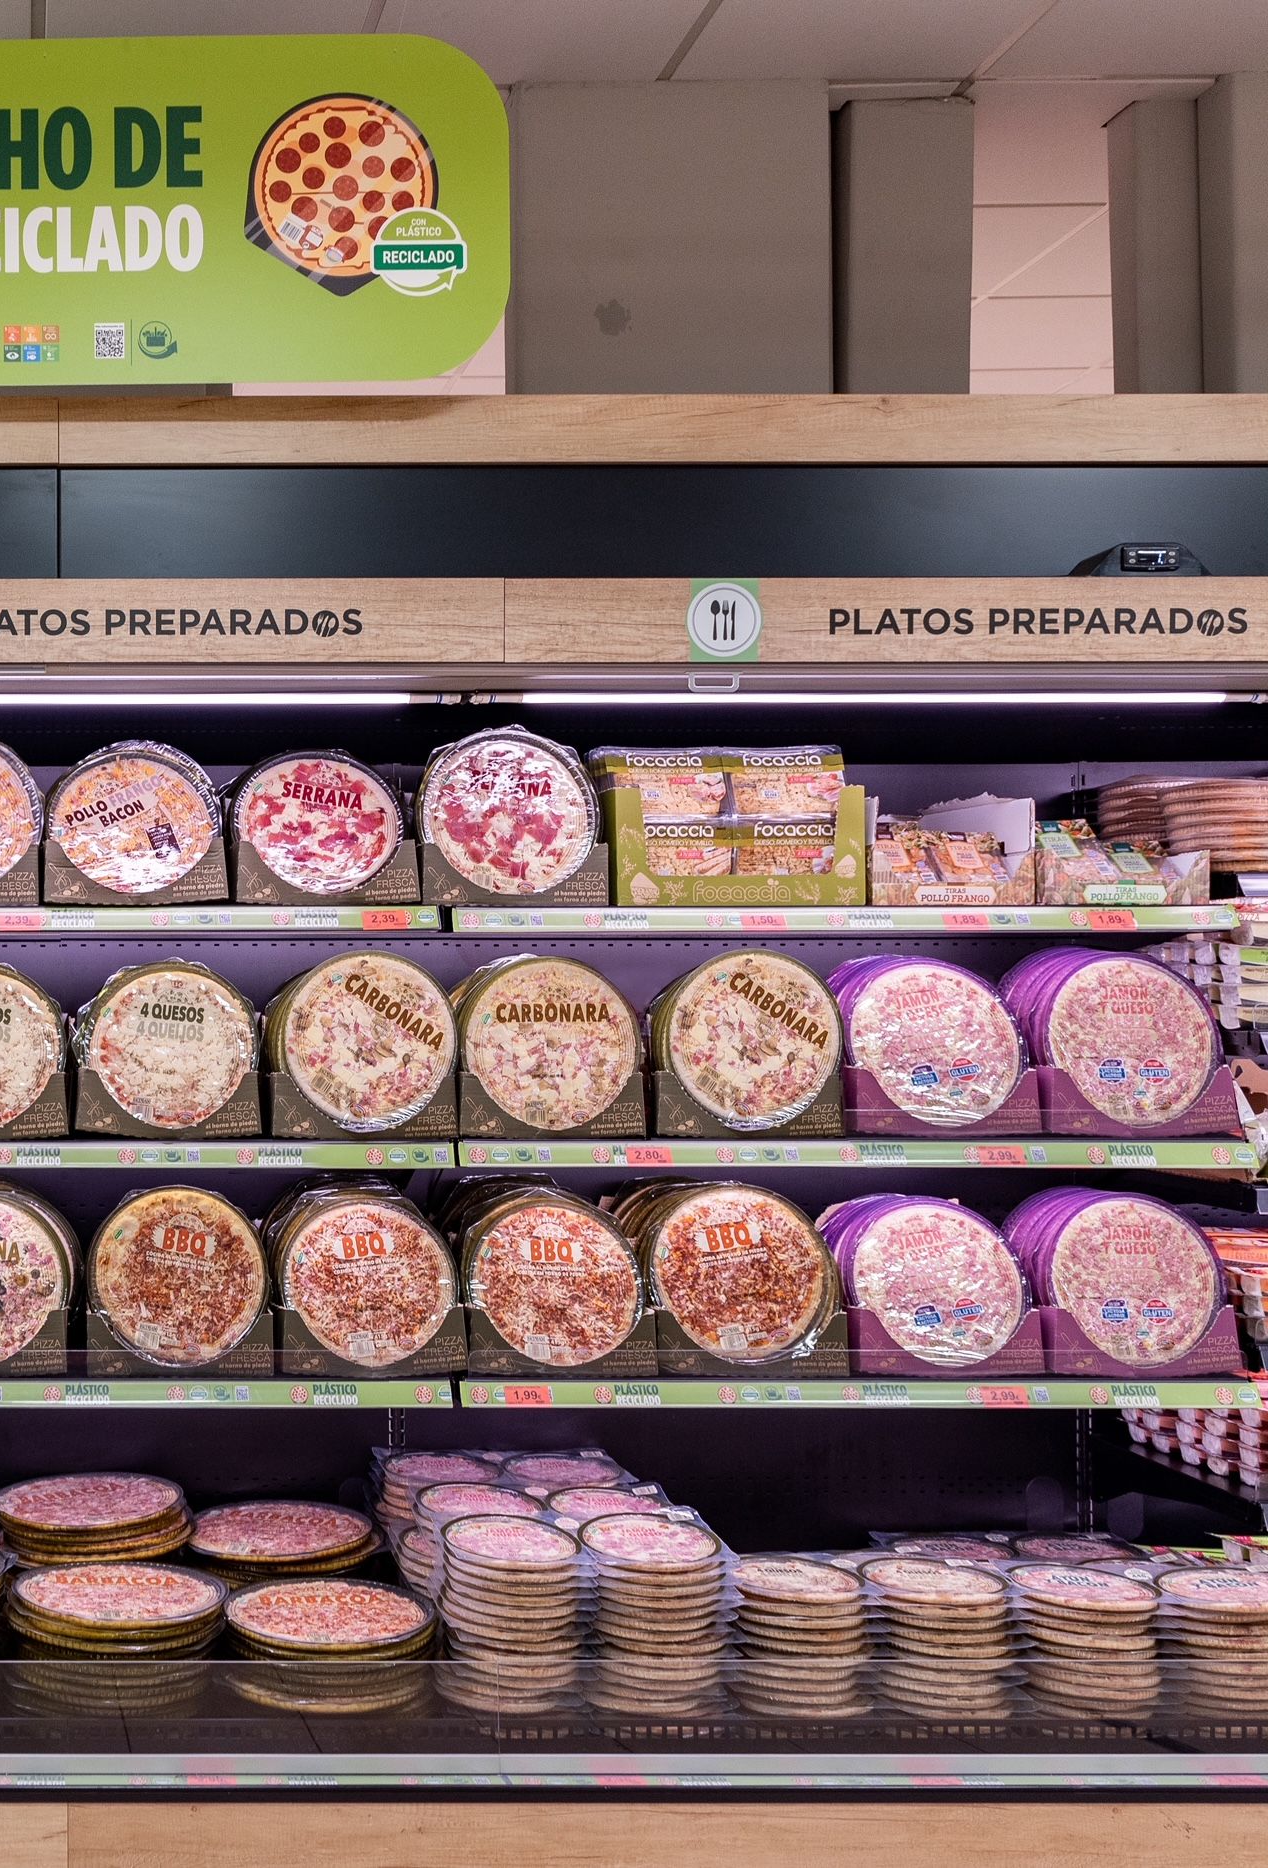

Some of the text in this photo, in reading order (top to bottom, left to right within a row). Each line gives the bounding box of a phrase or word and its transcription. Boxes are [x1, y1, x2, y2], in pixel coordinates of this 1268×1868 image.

[112, 106, 203, 187] DE
[396, 226, 442, 236] PLÁSTICO
[383, 251, 455, 263] RECICLADO
[106, 608, 363, 637] PREPARADOS
[829, 607, 1248, 637] PLATOS PREPARADOS
[625, 753, 702, 767] focaccia
[743, 754, 821, 766] focaccia
[64, 773, 161, 827] POLLO FRANGO
[282, 781, 362, 811] SERRANA
[99, 799, 145, 827] BACON
[754, 822, 834, 837] focaccia
[8, 873, 36, 881] PIZZA
[387, 869, 414, 877] PIZZA
[377, 878, 414, 887] FRESCA
[921, 894, 990, 902] POLLO FRANGO
[1091, 892, 1159, 901] POLLO FRANGO
[140, 1005, 204, 1024] 4 QUESOS
[345, 973, 445, 1051] CARBONARA
[496, 1003, 610, 1023] CARBONARA
[729, 972, 829, 1050] CARBONARA
[136, 1021, 204, 1041] 4 QUEIJOS
[951, 1065, 979, 1077] GLUTEN
[1140, 1068, 1170, 1078] GLUTEN
[227, 1103, 254, 1111] PIZZA
[217, 1112, 256, 1121] FRESCA
[602, 1113, 642, 1122] FRESCA
[16, 1147, 60, 1156] PLÁSTICO
[1108, 1145, 1153, 1156] PLÁSTICO
[16, 1157, 60, 1166] RECICLADO
[1112, 1156, 1156, 1166] RECICLADO
[706, 1223, 752, 1251] BBQ
[163, 1230, 207, 1257] BBQ
[342, 1232, 387, 1258] BBQ
[531, 1239, 574, 1263] BBQ
[954, 1305, 982, 1318] GLUTEN
[1142, 1308, 1172, 1318] GLUTEN
[313, 1384, 357, 1395] PLÁSTICO
[614, 1384, 658, 1395] PLÁSTICO
[314, 1395, 358, 1405] RECICLADO
[616, 1395, 660, 1405] RECICLADO
[55, 1575, 178, 1587] BARBACOA
[259, 1592, 381, 1605] BARBACOA
